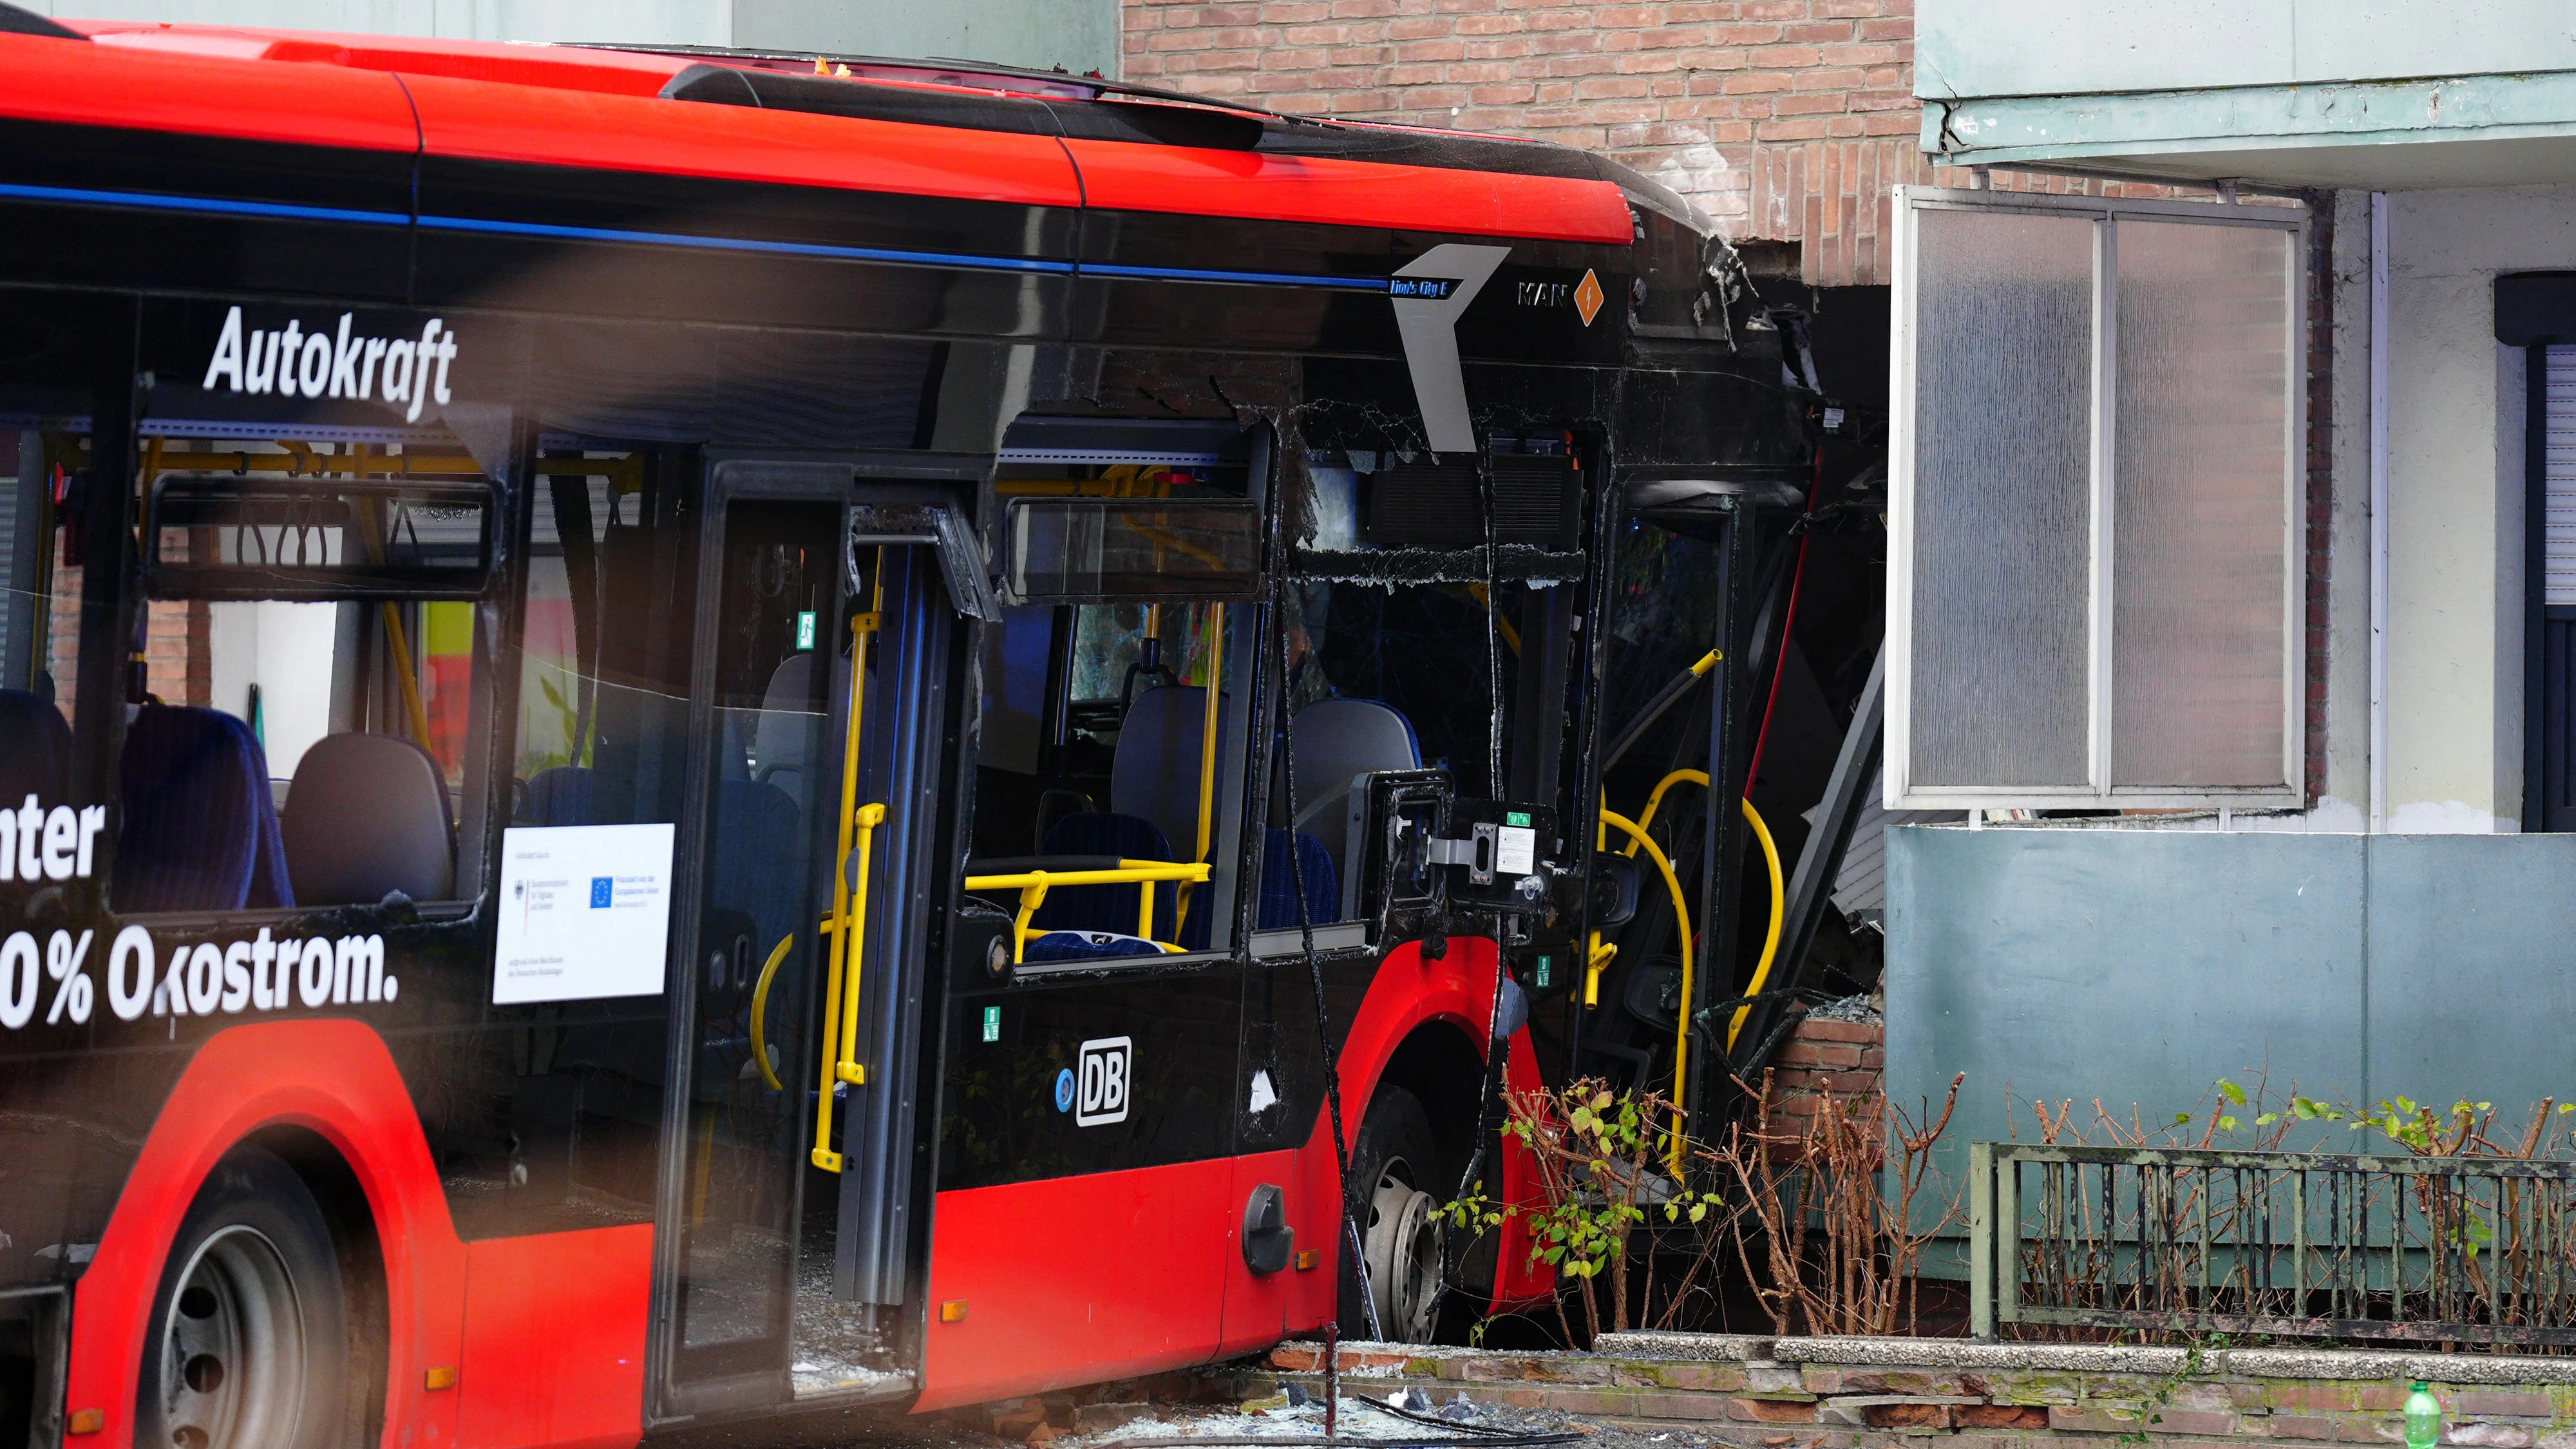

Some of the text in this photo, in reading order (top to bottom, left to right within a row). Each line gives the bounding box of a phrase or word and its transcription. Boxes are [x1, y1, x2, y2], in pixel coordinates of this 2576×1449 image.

[1390, 279, 1448, 298] Lion's City E
[1518, 282, 1568, 307] MAN
[202, 305, 458, 424] Autokraft
[1083, 1051, 1124, 1112] DB
